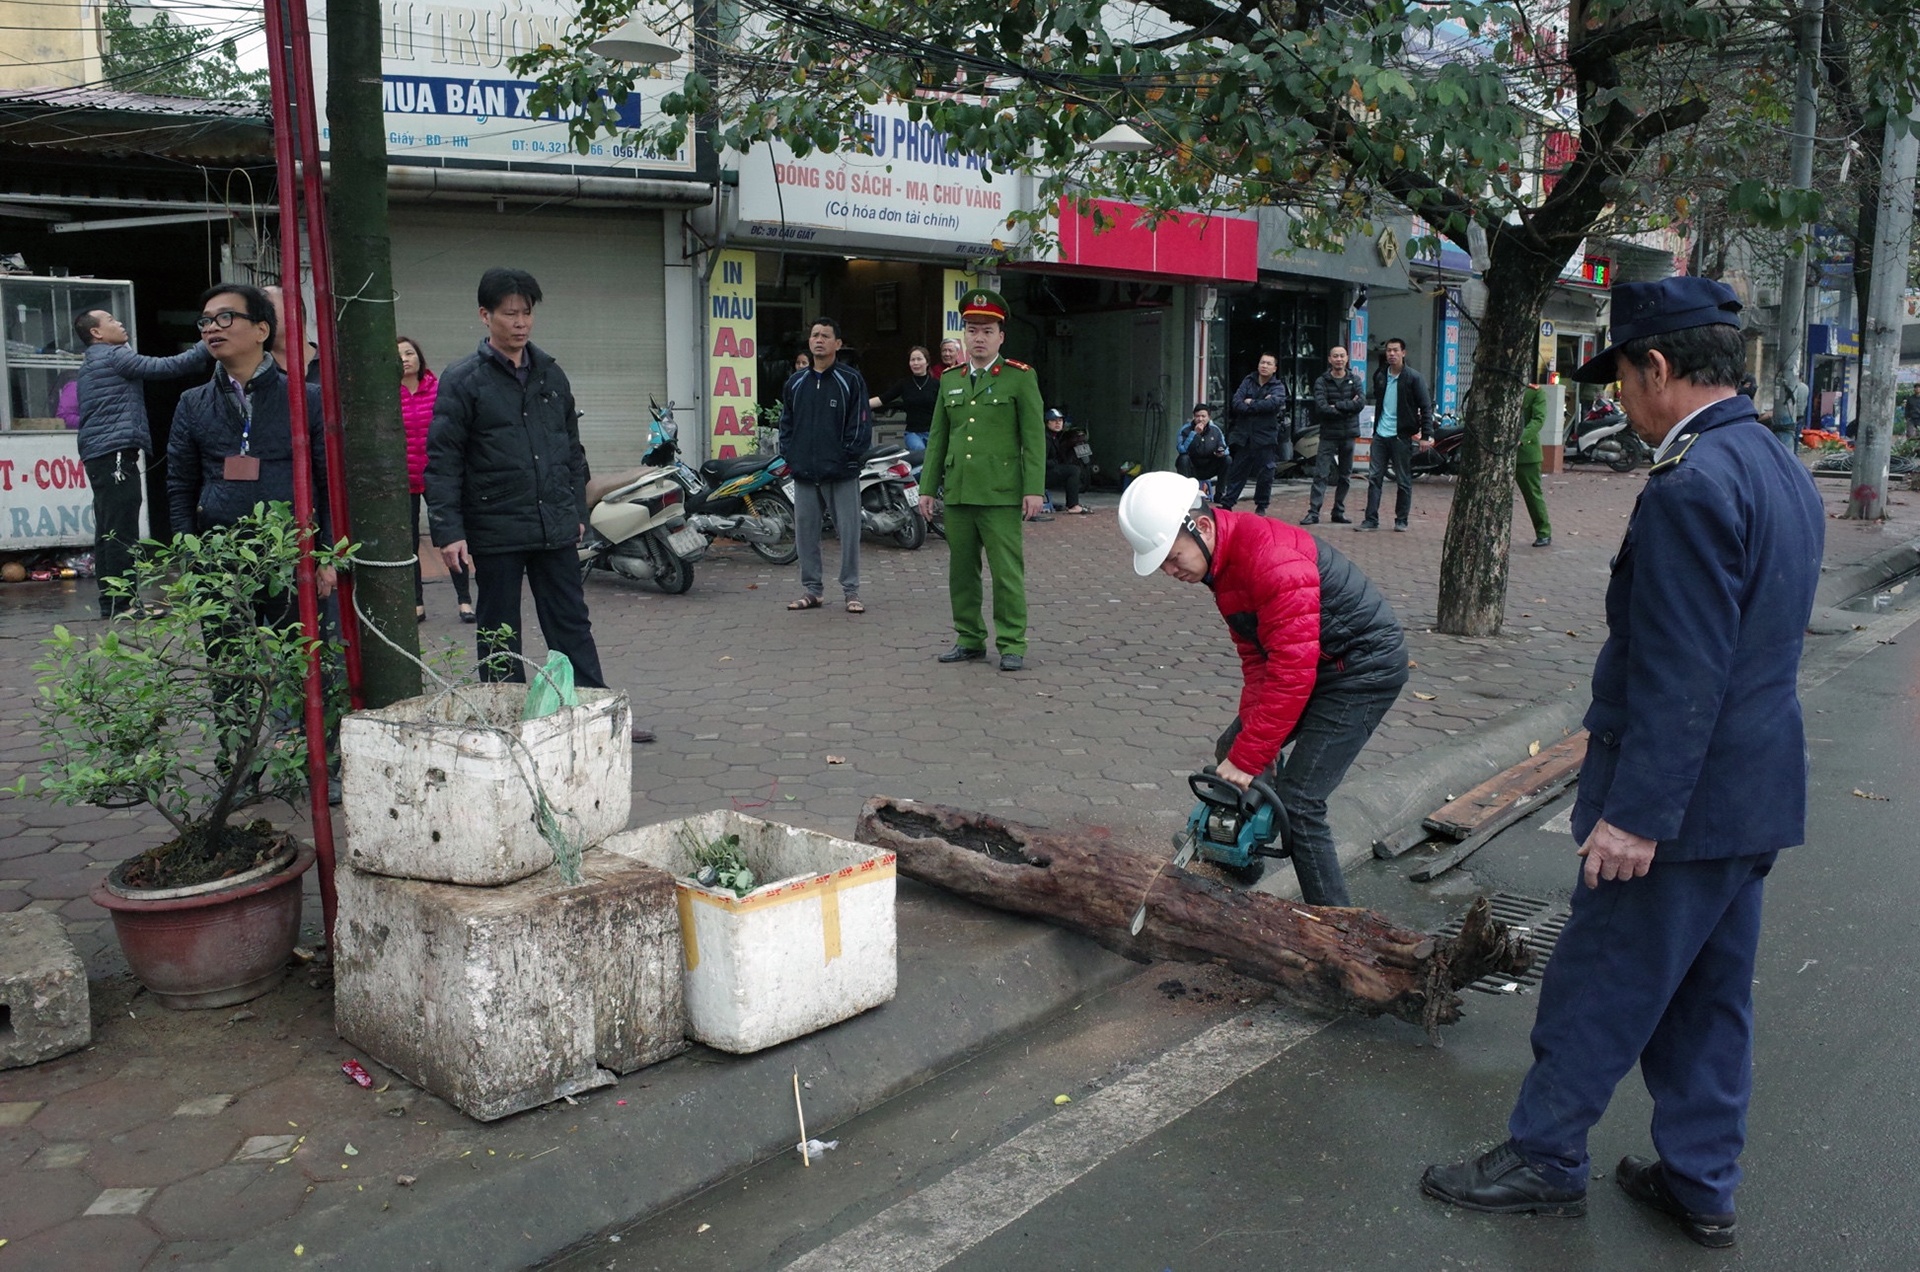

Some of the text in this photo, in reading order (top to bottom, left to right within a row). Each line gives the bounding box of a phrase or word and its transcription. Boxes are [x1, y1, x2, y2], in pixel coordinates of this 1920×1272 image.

[446, 79, 506, 116] BÁN
[390, 131, 415, 146] Giấy
[452, 136, 469, 147] HN
[511, 139, 529, 151] ĐT:
[775, 161, 1001, 210] ĐÓNG SỔ SÁCH MẠ CHỮ VÀNG
[825, 200, 960, 232] (Có hóa đơn tài chính)
[722, 261, 743, 284] IN
[954, 280, 969, 301] IN
[712, 291, 754, 321] MÀU
[712, 327, 755, 359] A0
[1541, 325, 1553, 337] 44
[713, 366, 752, 397] A1
[713, 406, 756, 436] A2
[34, 455, 87, 490] CƠM
